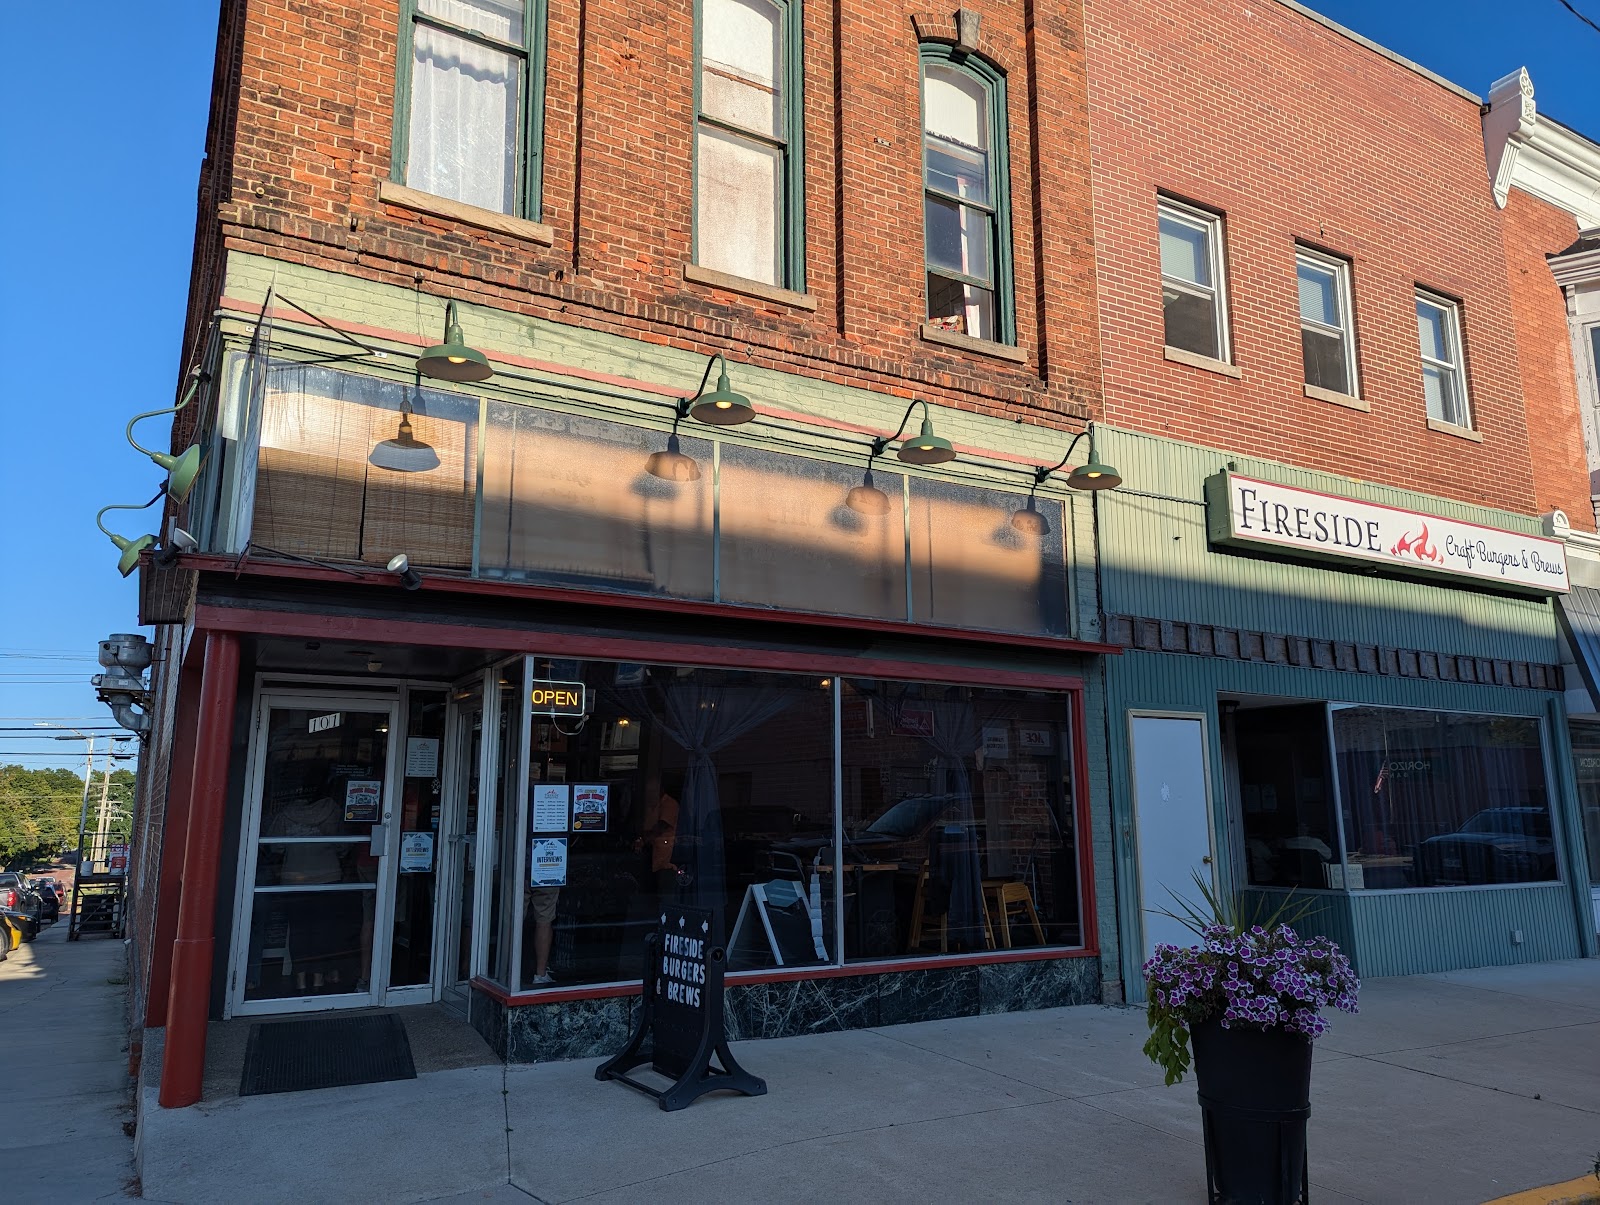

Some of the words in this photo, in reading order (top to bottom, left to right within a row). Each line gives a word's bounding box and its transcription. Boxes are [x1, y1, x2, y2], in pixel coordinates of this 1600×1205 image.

[1239, 488, 1382, 551] FIRESIDE
[1446, 535, 1475, 569] Craft
[1476, 540, 1520, 574] Burgers
[1521, 549, 1529, 569] &
[1531, 551, 1563, 575] Brews
[532, 689, 578, 706] OPEN
[312, 714, 338, 732] 101
[664, 933, 704, 960] FIRESIDE
[663, 955, 706, 985] BURGERS
[667, 981, 701, 1008] BREWS
